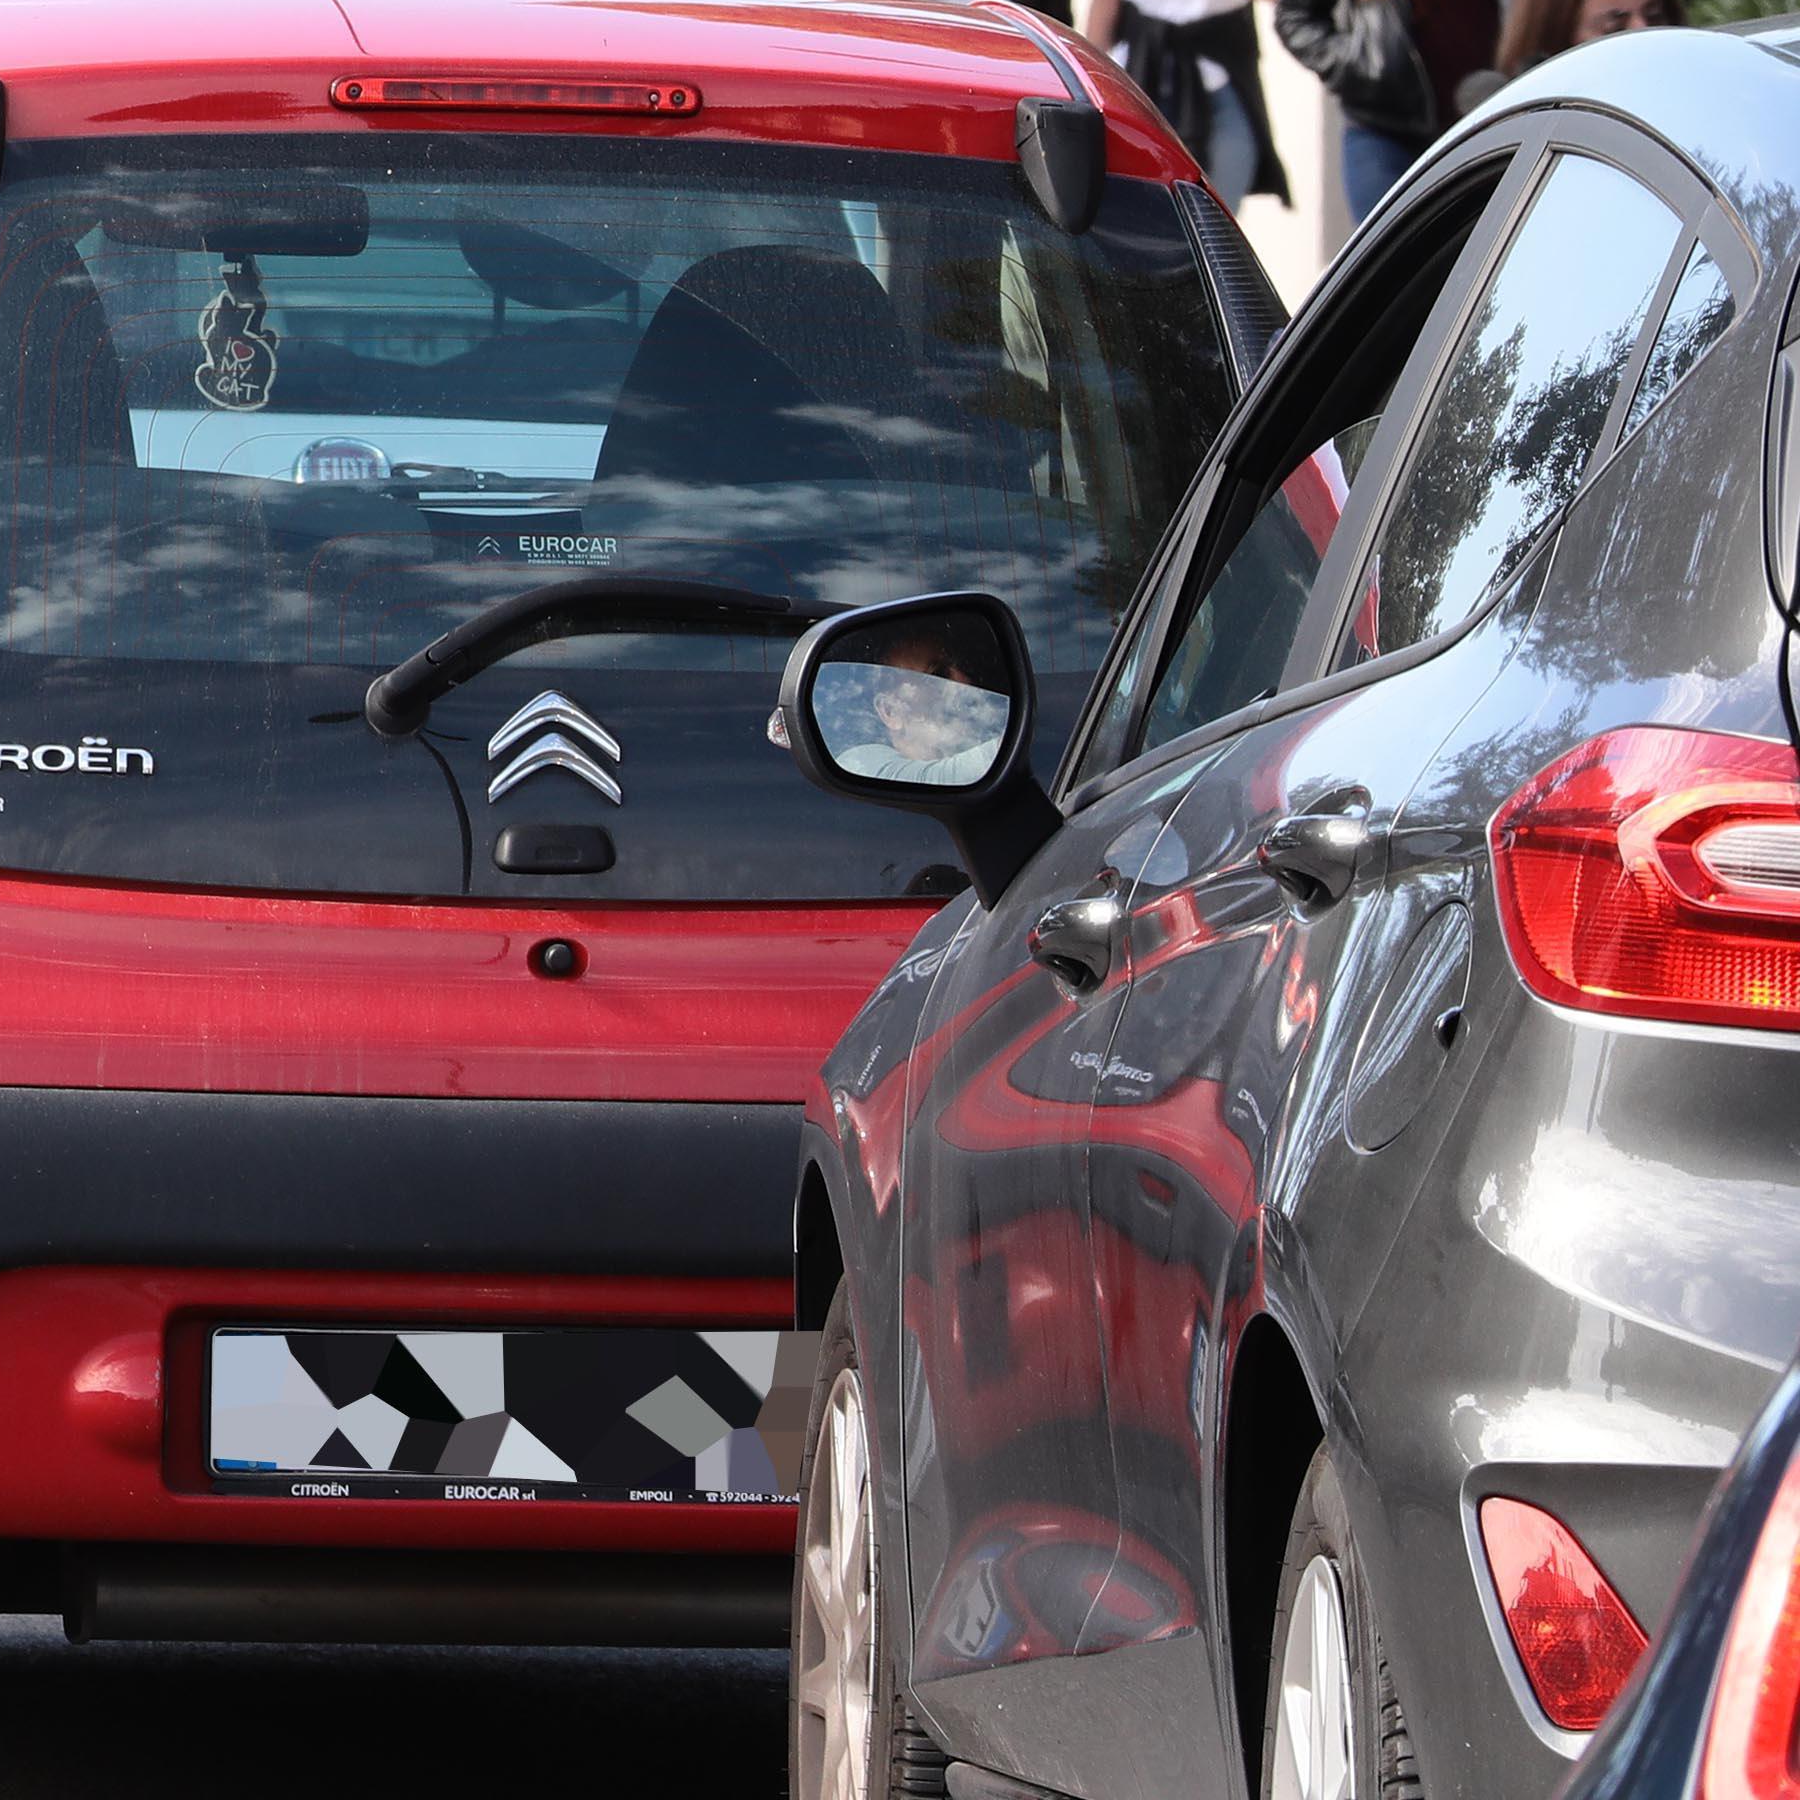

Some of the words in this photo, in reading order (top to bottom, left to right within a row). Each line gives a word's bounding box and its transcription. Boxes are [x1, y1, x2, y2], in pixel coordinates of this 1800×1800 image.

[220, 357, 252, 379] MY
[216, 376, 260, 400] CAT
[319, 456, 374, 481] FIAT
[519, 536, 617, 553] EUROCAR
[291, 1482, 349, 1497] CITROËN
[445, 1485, 520, 1500] EUROCAR
[522, 1489, 537, 1501] srl
[629, 1491, 673, 1501] EMPOLI
